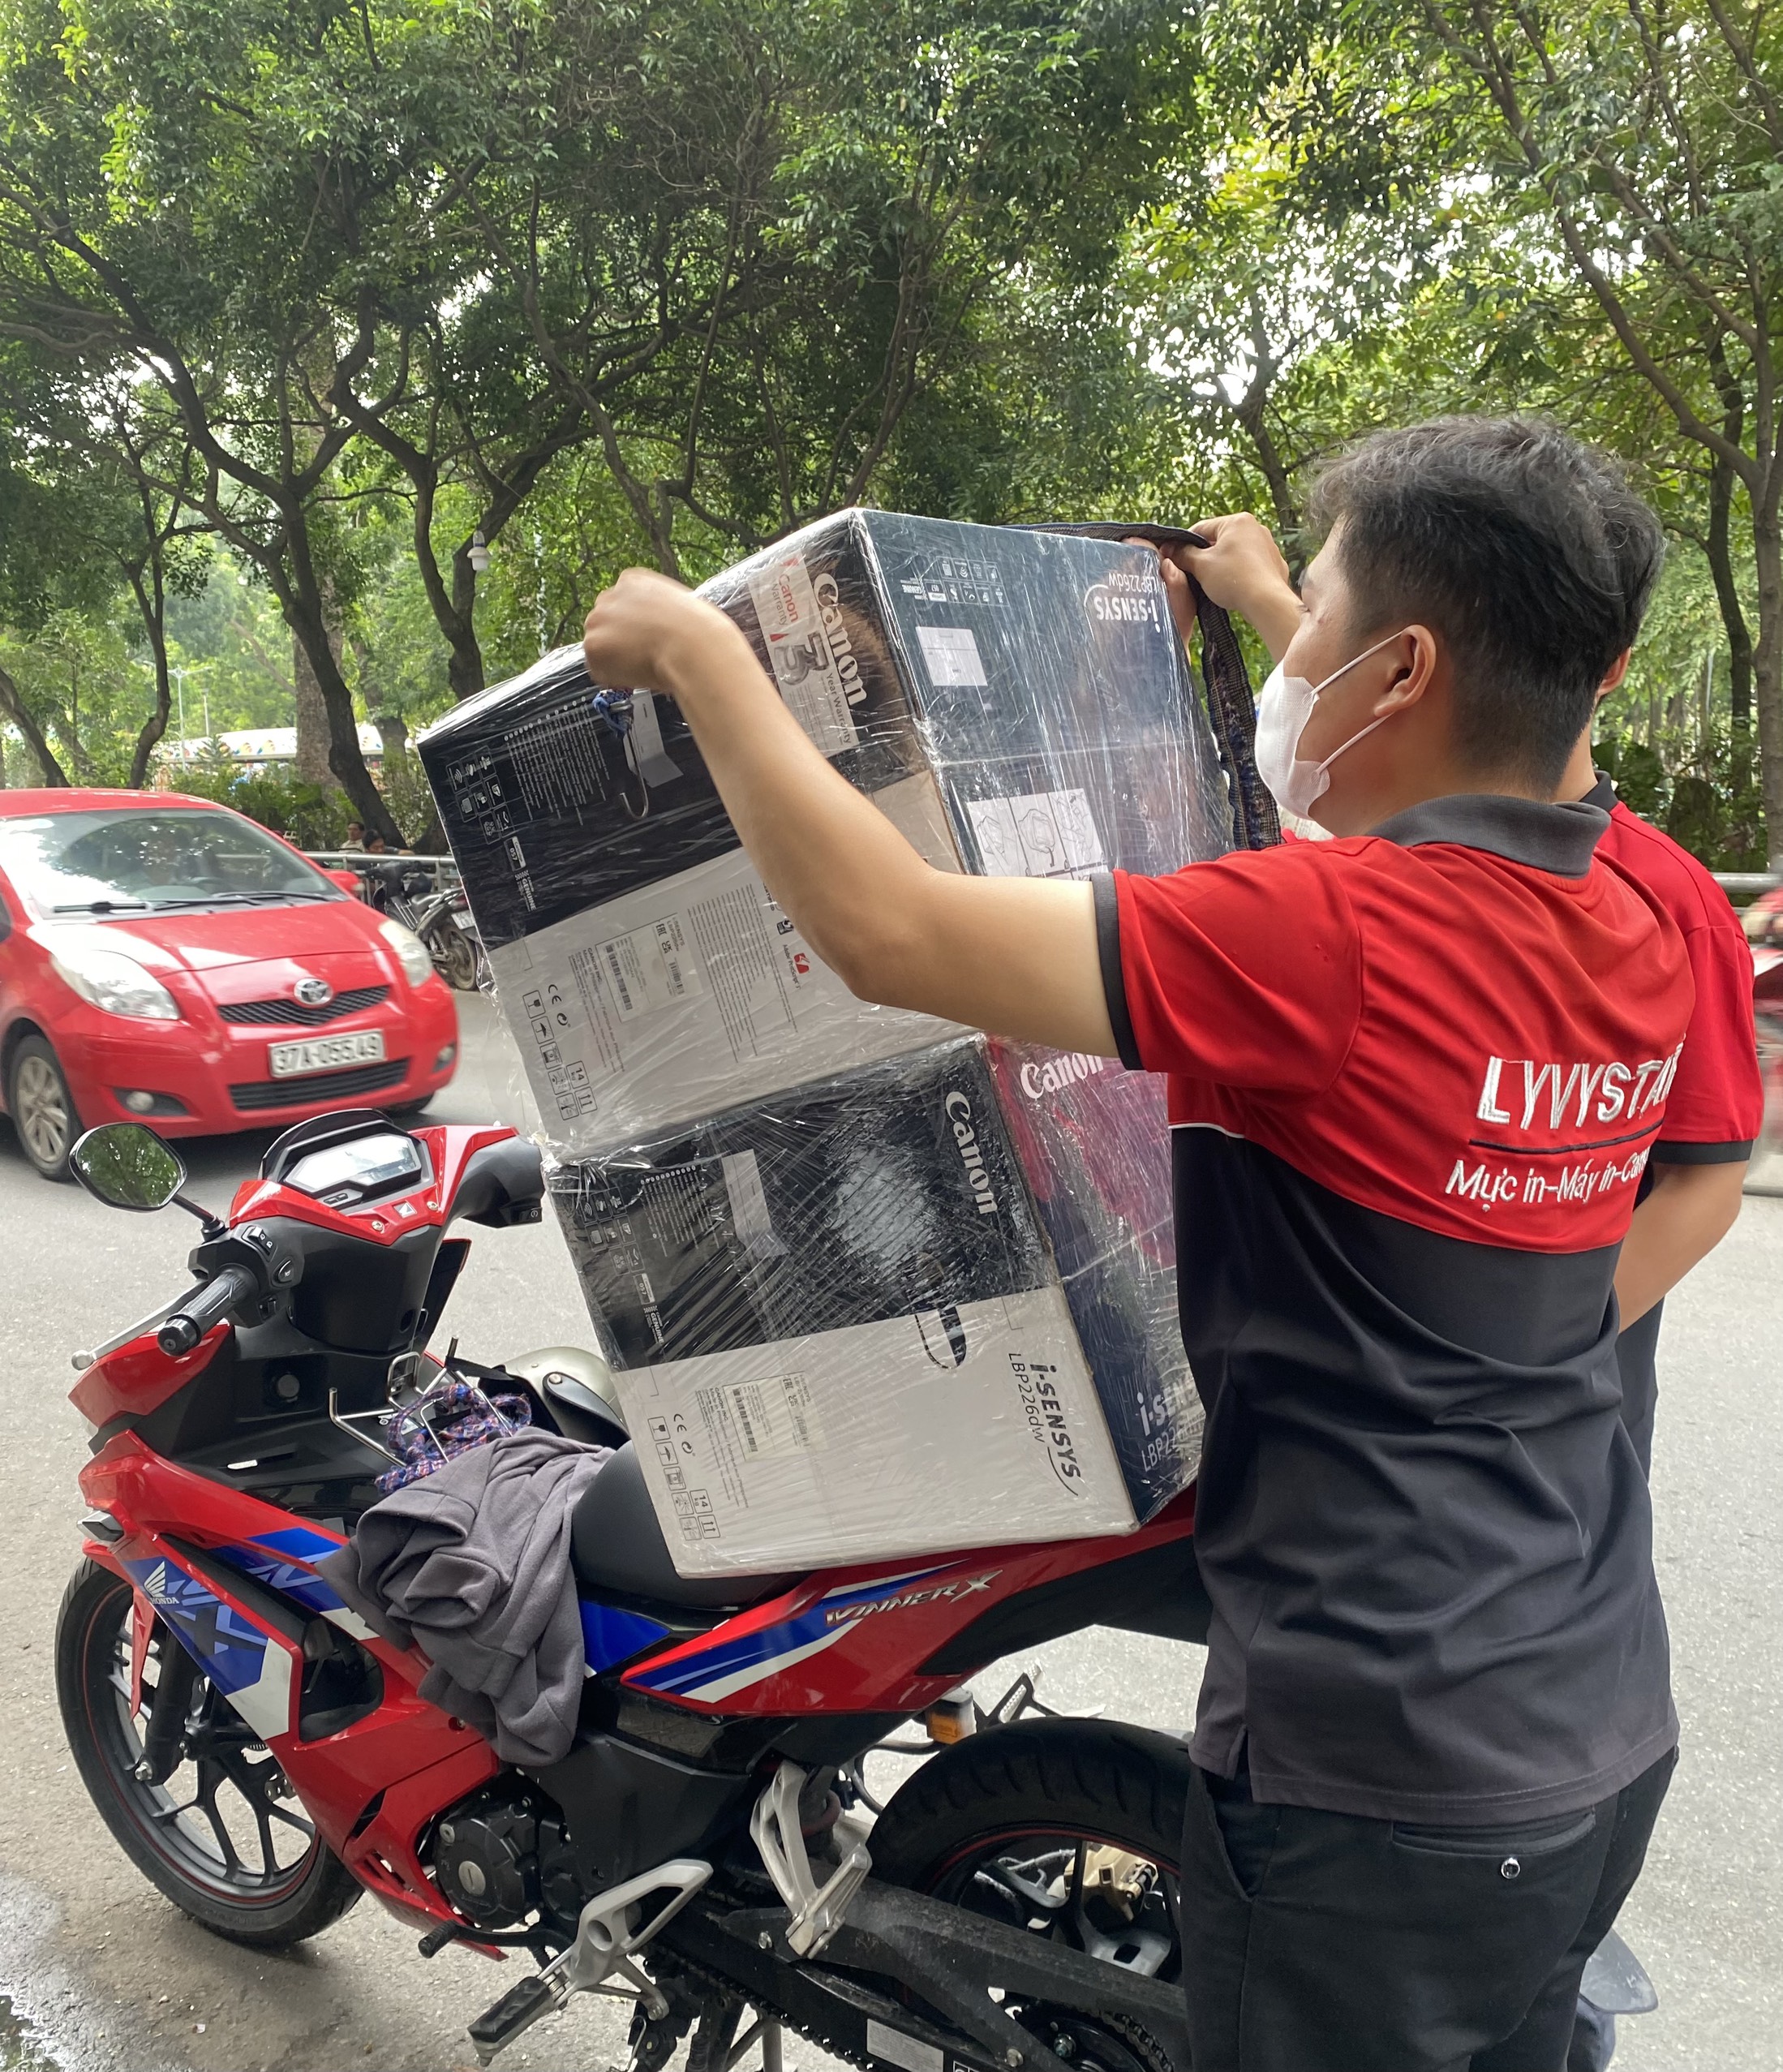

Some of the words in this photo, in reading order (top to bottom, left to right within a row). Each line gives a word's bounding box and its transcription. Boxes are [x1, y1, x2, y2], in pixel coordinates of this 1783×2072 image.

[778, 574, 800, 623] Canon
[1108, 572, 1158, 593] LBP226dw
[1093, 595, 1161, 634] i-SENSYS
[814, 573, 867, 706] Canon
[826, 673, 837, 694] Year
[834, 697, 851, 745] Warranty
[509, 847, 518, 861] 057
[522, 878, 537, 912] GENUINE
[576, 1067, 585, 1081] 14
[1020, 1052, 1104, 1099] Canon
[945, 1091, 998, 1214] Canon
[1445, 1159, 1518, 1212] Mực
[1523, 1159, 1601, 1205] in-Máy
[639, 1283, 647, 1295] 057
[651, 1313, 664, 1343] GENUINE
[1008, 1353, 1046, 1442] LBP226dw
[1029, 1364, 1081, 1478] i-SENSYS
[699, 1494, 708, 1507] 14
[150, 1597, 180, 1605] HONDA
[826, 1582, 960, 1625] WINNER
[948, 1569, 1003, 1604] X
